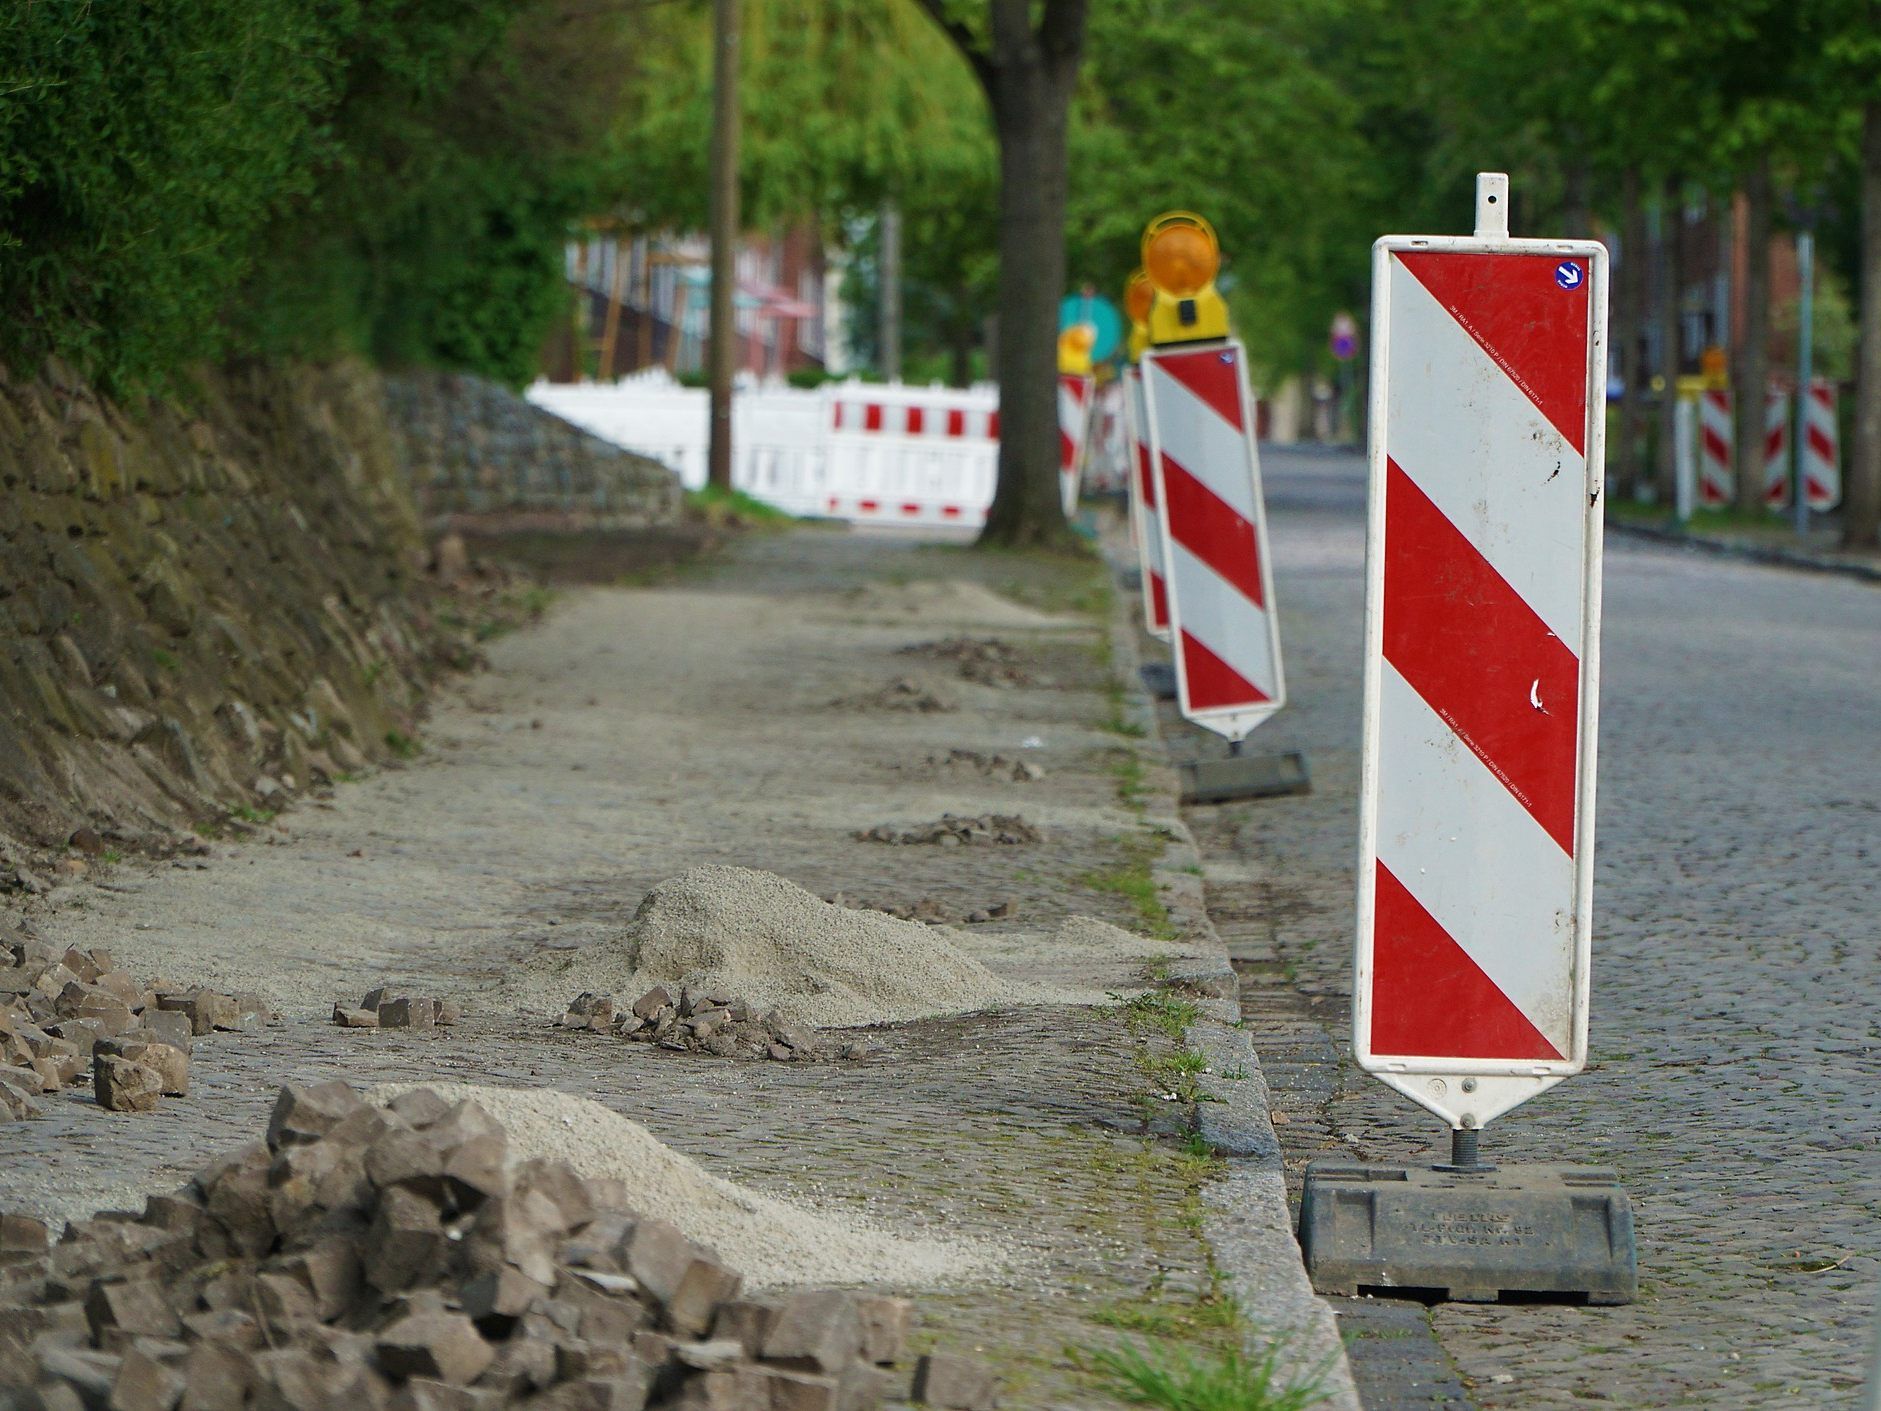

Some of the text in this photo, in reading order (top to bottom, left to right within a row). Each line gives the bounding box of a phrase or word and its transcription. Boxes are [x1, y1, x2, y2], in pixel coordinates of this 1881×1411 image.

[1450, 305, 1458, 314] 3M
[1499, 358, 1509, 368] DIN
[1521, 381, 1530, 391] DIN
[1528, 389, 1543, 405] 6171-1
[1440, 708, 1448, 716] 3M
[1488, 760, 1498, 771] DIN
[1510, 783, 1520, 794] DIN
[1517, 791, 1533, 807] 6171-1
